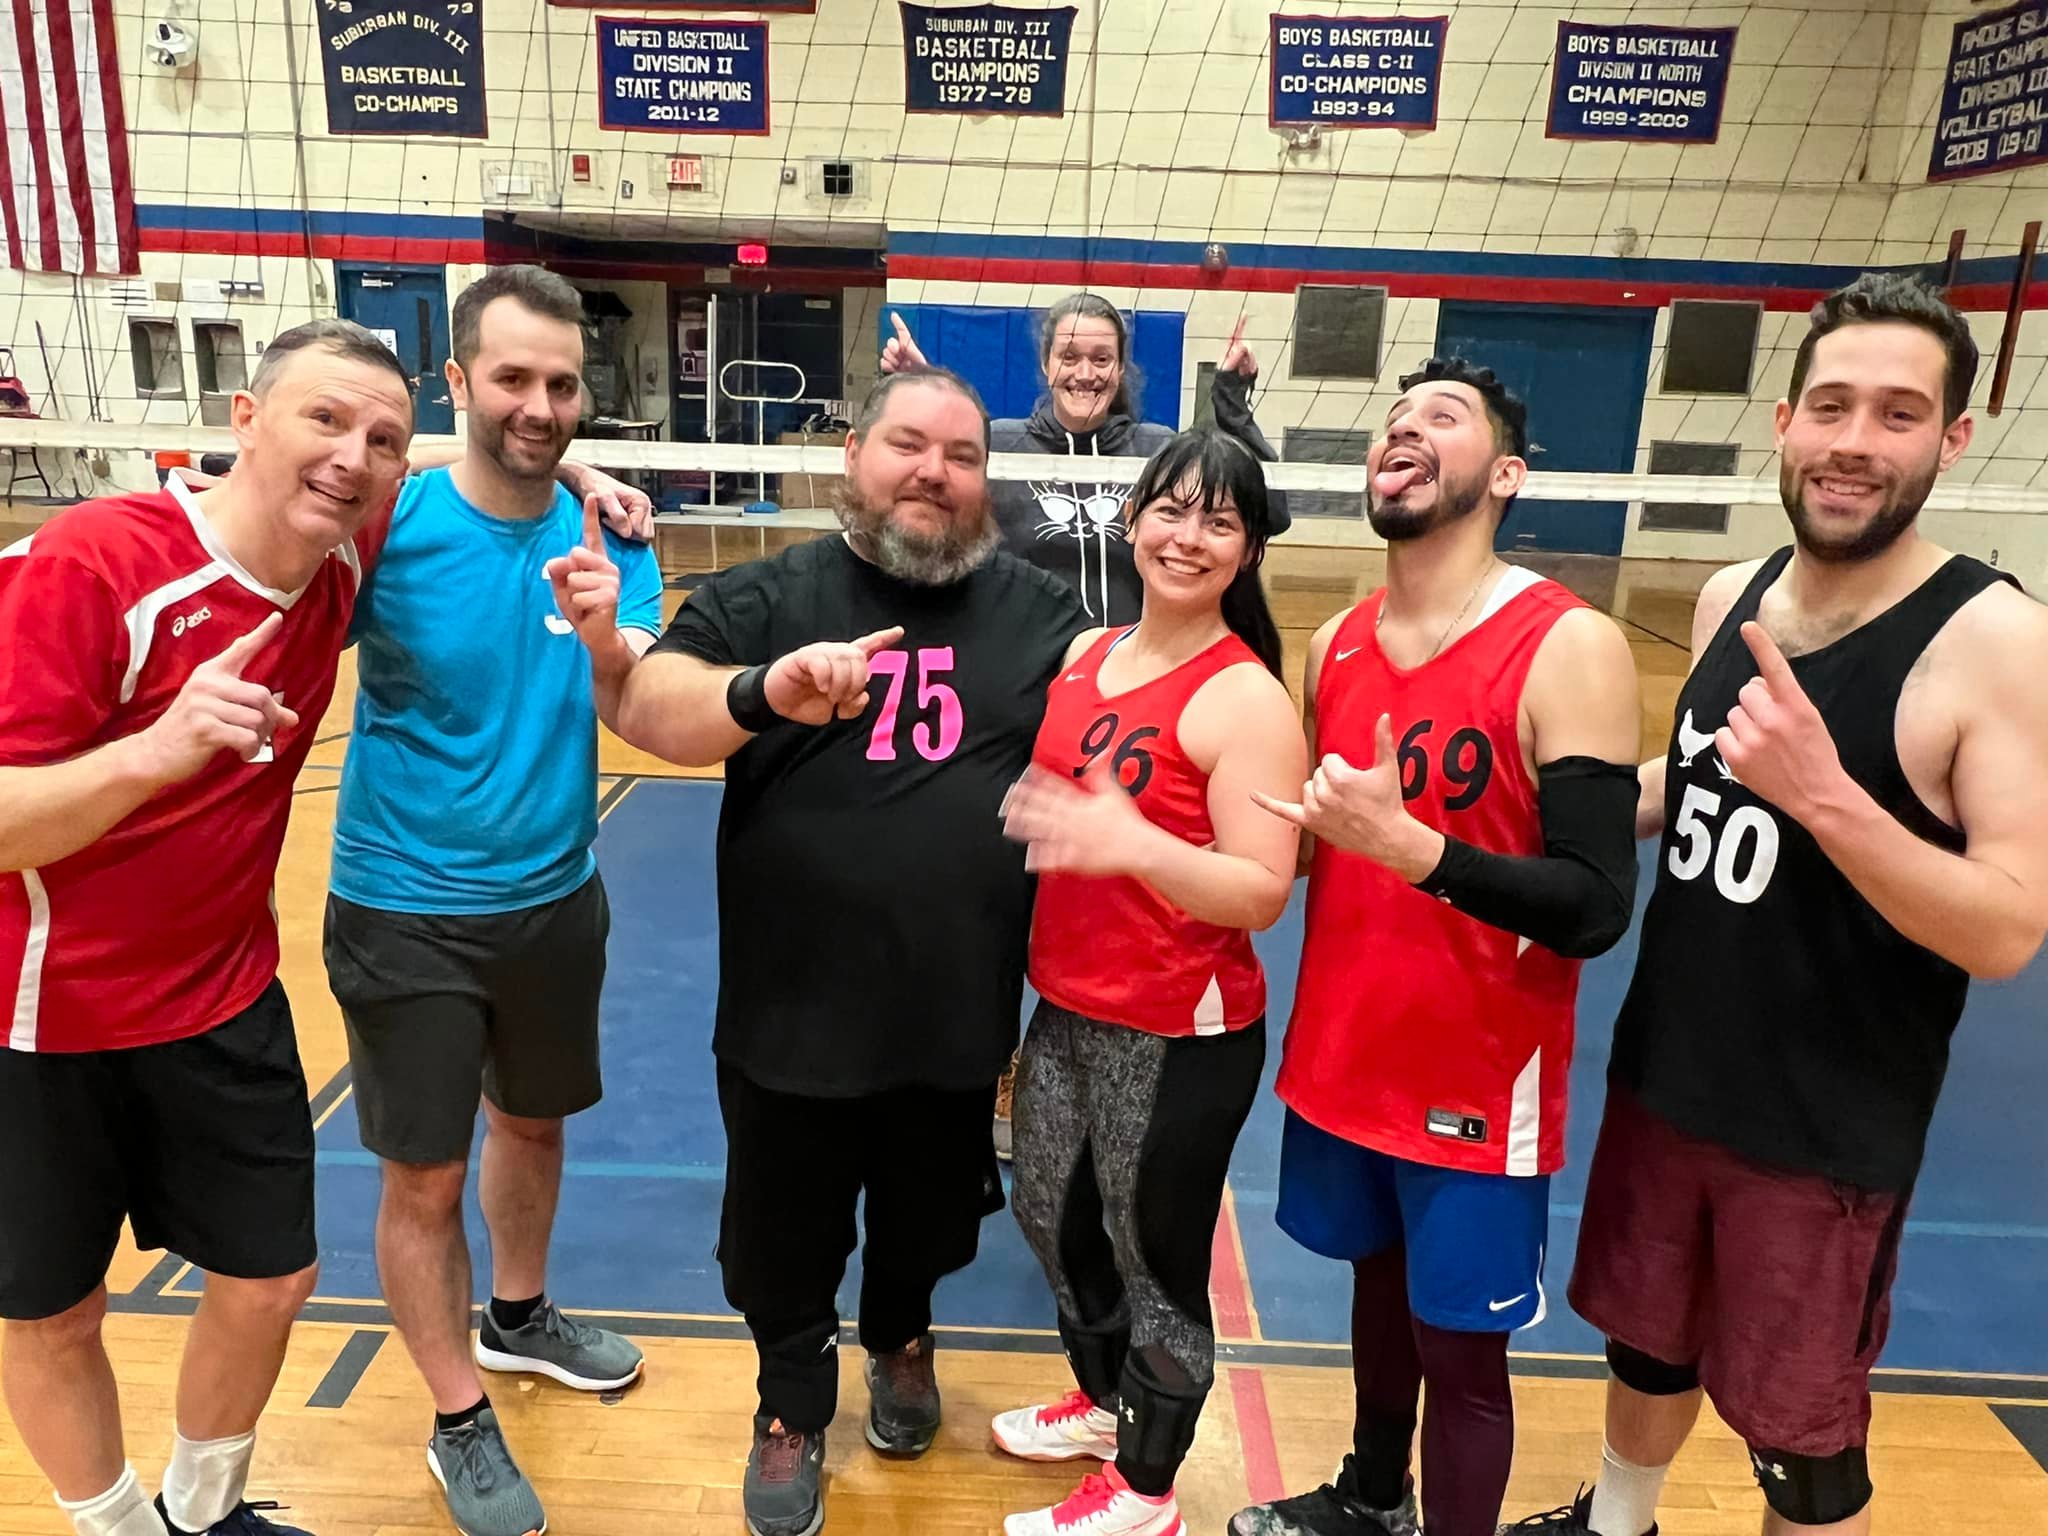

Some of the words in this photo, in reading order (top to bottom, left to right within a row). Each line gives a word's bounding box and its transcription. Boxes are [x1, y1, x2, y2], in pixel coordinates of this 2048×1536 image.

[447, 3, 474, 15] 73
[331, 11, 407, 51] SUBURBAN
[413, 15, 440, 36] DIV.
[443, 30, 470, 54] III
[925, 18, 988, 33] SUBURBAN
[994, 20, 1018, 35] DIV.
[1024, 22, 1050, 35] III
[667, 31, 750, 51] BASKETBALL
[915, 36, 1056, 60] BASKETBALL
[1279, 28, 1322, 46] BOYS
[1329, 29, 1434, 48] BASKETBALL
[1567, 35, 1610, 54] BOYS
[1616, 37, 1719, 58] BASKETBALL
[633, 54, 710, 74] DIVISION
[717, 57, 733, 74] II
[931, 61, 1040, 83] CHAMPIONS
[1302, 53, 1370, 69] CLASS
[1378, 55, 1414, 70] C-II
[1578, 61, 1635, 79] DIVISION
[1640, 63, 1652, 80] II
[1658, 64, 1703, 83] NORTH
[1952, 51, 1995, 83] STATE
[341, 66, 466, 86] BASKETBALL
[1280, 75, 1427, 94] CO-CHAMPIONS
[615, 77, 662, 99] STATE
[669, 79, 751, 102] CHAMPIONS
[939, 85, 1032, 104] 1977-78
[1568, 85, 1706, 107] CHAMPIONS
[1959, 73, 2024, 110] DIVISION
[354, 95, 458, 114] CO-CHAMPS
[648, 106, 720, 122] 2011-12
[1311, 100, 1395, 116] 1993-94
[1581, 110, 1689, 128] 1999-2000
[1944, 138, 1989, 167] 2008
[865, 646, 963, 761] 75
[1073, 713, 1160, 797] 96
[1397, 719, 1494, 811] 69
[1668, 783, 1780, 905] 50
[1468, 1121, 1477, 1135] L
